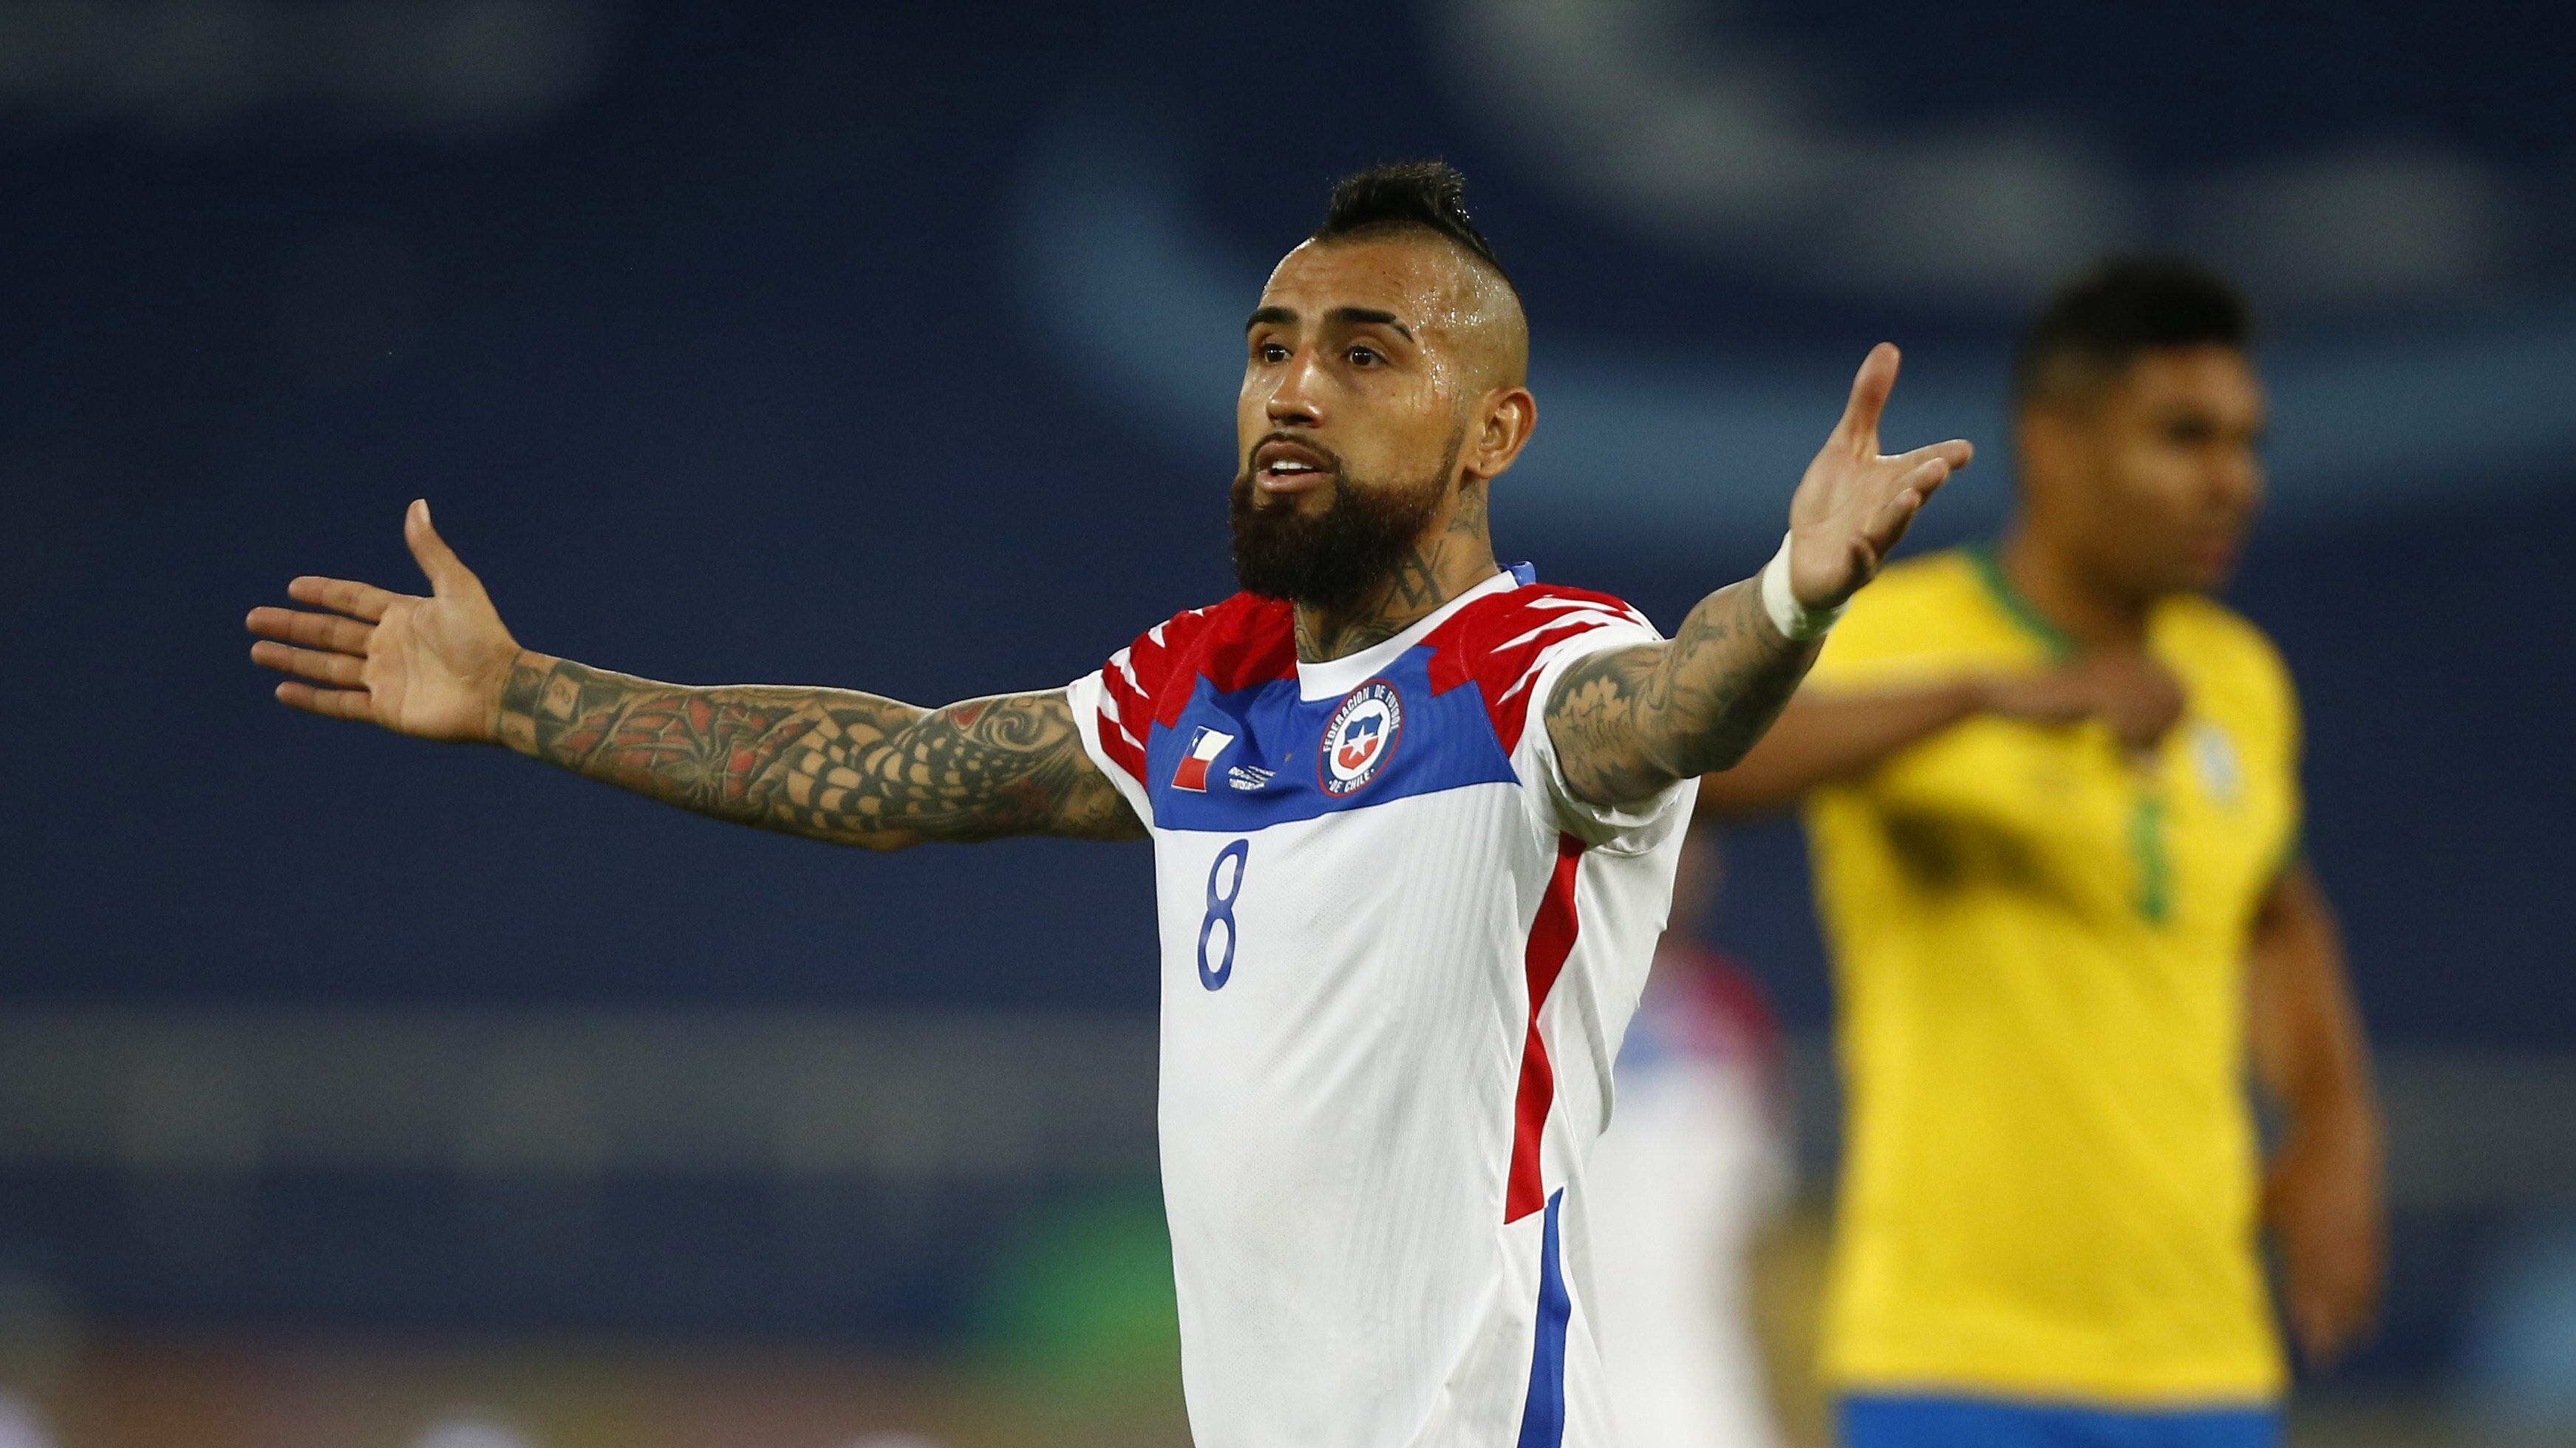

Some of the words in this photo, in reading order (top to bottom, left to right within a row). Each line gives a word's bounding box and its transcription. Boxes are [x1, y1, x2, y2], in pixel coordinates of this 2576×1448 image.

[1323, 686, 1369, 752] FEDERACION
[1374, 684, 1386, 699] DE
[1385, 689, 1401, 733] FUTBOL
[1329, 780, 1343, 793] DE
[1344, 771, 1371, 793] CHILE
[1198, 839, 1249, 991] 8
